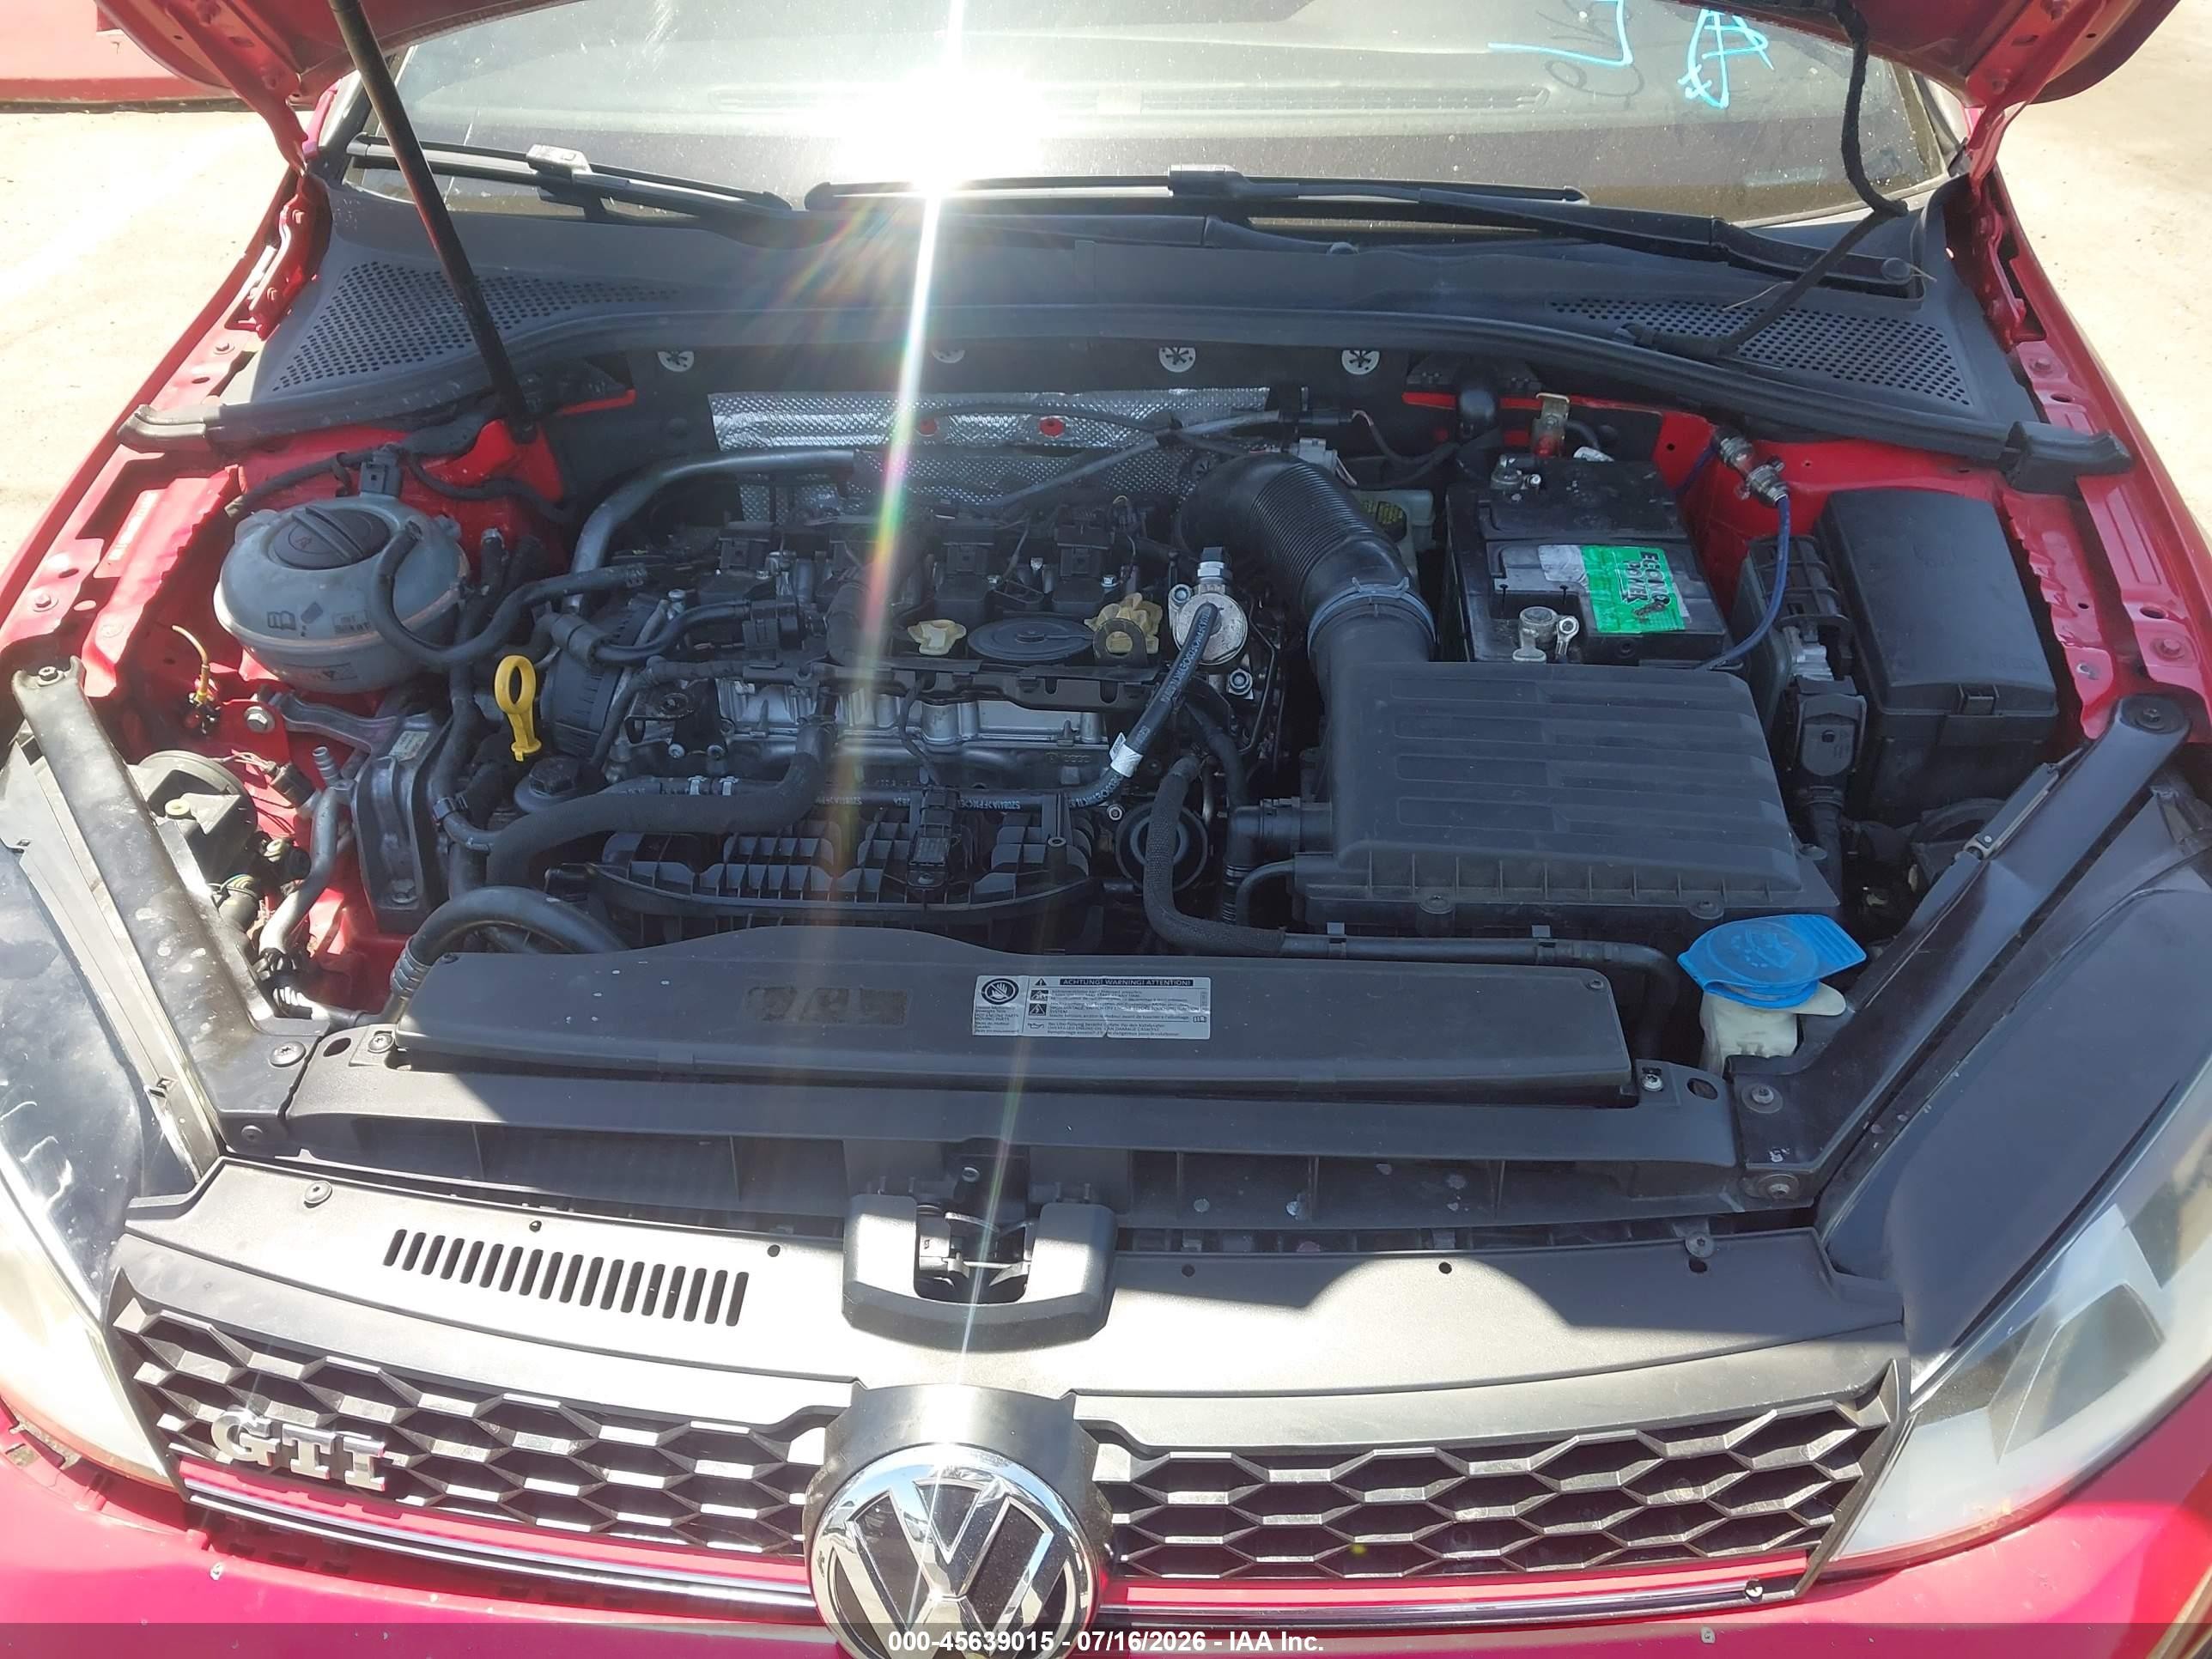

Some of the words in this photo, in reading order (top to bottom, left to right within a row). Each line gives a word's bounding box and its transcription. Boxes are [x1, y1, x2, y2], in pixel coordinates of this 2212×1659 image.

[1625, 560, 1649, 605] POWER
[1640, 550, 1671, 605] ECONO
[211, 1405, 386, 1492] GTI
